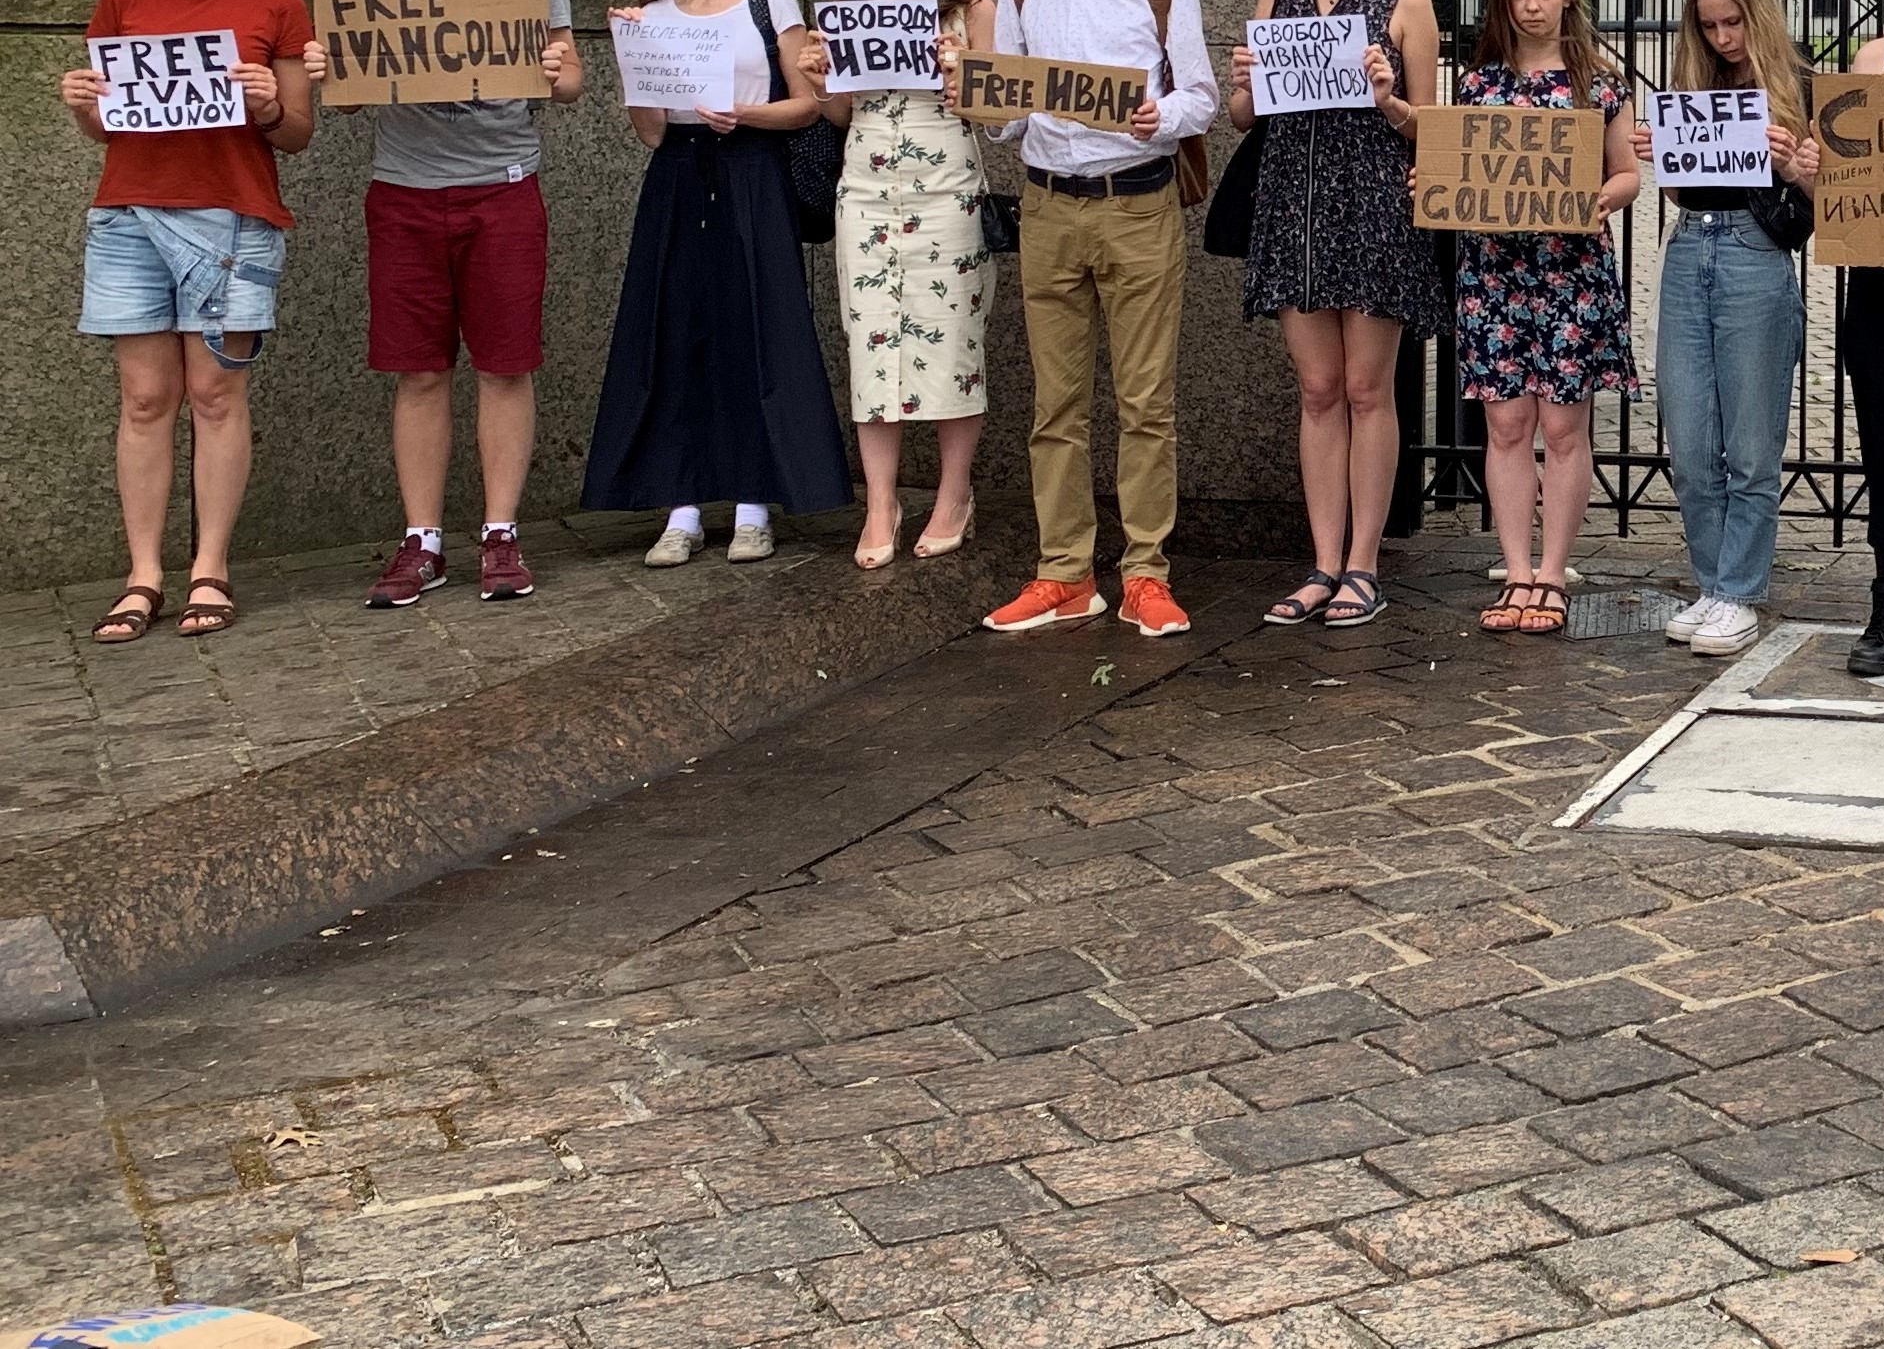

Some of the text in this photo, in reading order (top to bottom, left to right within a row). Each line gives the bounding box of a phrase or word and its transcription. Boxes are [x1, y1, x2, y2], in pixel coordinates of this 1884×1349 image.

[817, 3, 938, 35] СВОБОДУ
[1253, 18, 1352, 47] СВОБОДУ
[98, 35, 227, 82] FREE
[828, 38, 942, 80] ИВАНУ
[1259, 42, 1333, 69] ИВАНУ
[118, 76, 232, 107] IVAN
[1045, 66, 1145, 124] ИВАН
[1265, 67, 1369, 105] ГОЛУНОВУ
[106, 102, 236, 128] GOLUNOV
[1656, 91, 1763, 127] FREE
[1461, 113, 1576, 154] FREE
[1459, 153, 1572, 187] IVAN
[1662, 150, 1769, 174] GOLUNOV
[1822, 166, 1873, 185] НАШЕМУ
[1421, 185, 1601, 228] GOLUNOV
